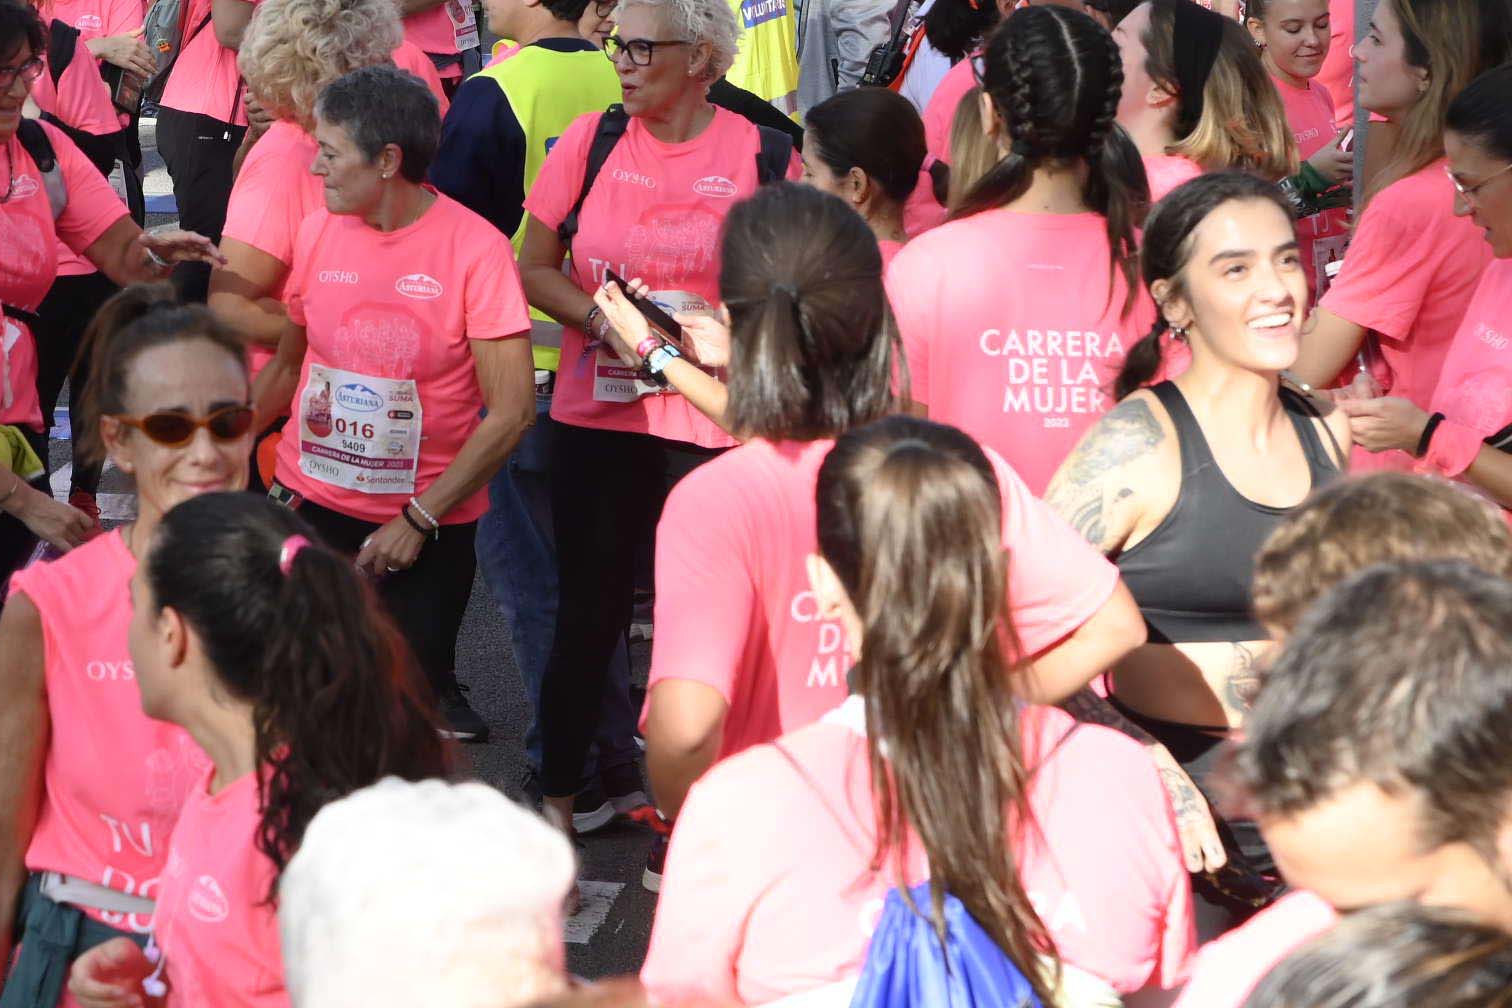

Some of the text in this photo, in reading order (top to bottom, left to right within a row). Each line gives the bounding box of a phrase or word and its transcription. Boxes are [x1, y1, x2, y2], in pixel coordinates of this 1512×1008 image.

[978, 327, 1125, 358] CARRERA
[1008, 358, 1100, 385] DE LA
[1002, 386, 1107, 413] MUJER
[335, 417, 375, 439] 016
